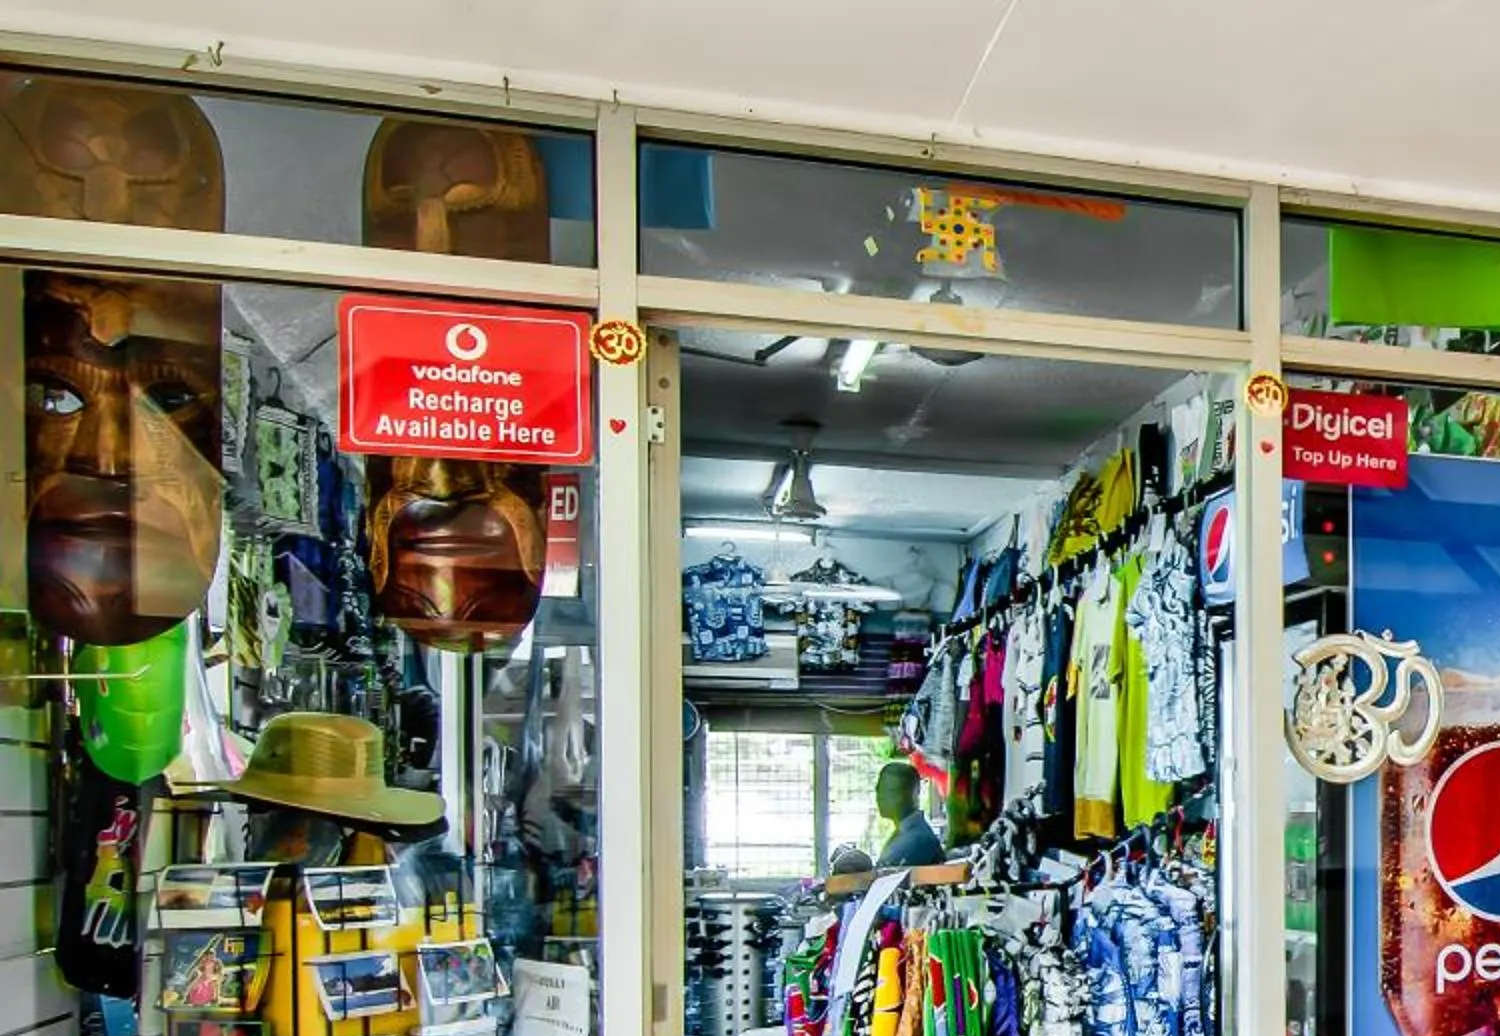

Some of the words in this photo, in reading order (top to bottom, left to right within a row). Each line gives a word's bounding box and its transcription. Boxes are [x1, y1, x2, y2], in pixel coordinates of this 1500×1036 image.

[411, 364, 522, 386] vodafone
[409, 388, 523, 420] Recharge
[375, 415, 491, 442] Available
[498, 421, 555, 445] Here
[1292, 403, 1394, 440] Digicel
[1292, 446, 1324, 467] Top
[1328, 450, 1352, 470] Up
[1356, 452, 1397, 471] Here
